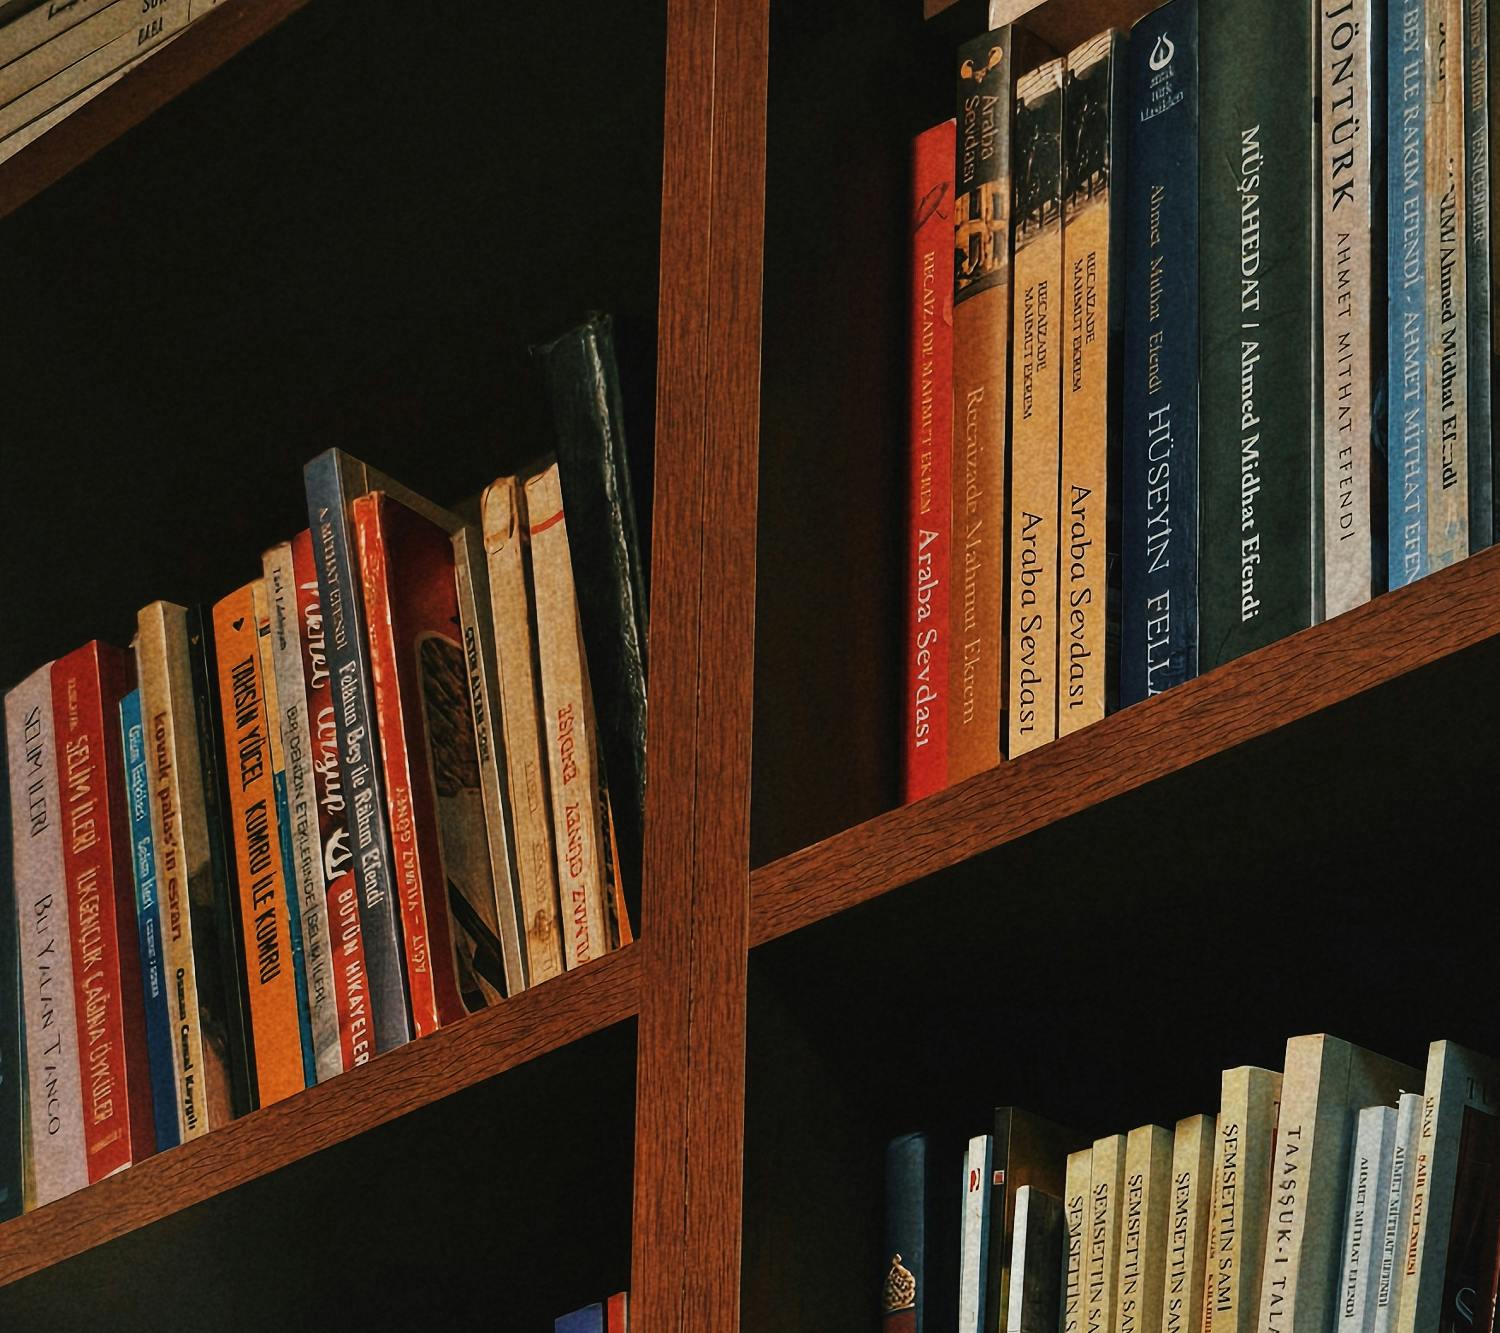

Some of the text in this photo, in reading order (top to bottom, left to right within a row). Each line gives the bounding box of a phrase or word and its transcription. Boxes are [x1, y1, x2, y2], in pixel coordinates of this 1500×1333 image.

[1336, 231, 1350, 317] AHMET
[1238, 124, 1264, 622] MÜŞAHEDAT Ahmed Midhat Efendi
[1403, 310, 1420, 397] AHMET
[1146, 403, 1176, 575] HÜSEYİN
[963, 526, 983, 629] Mahmut
[1019, 511, 1042, 734] Araba Sevdası
[1069, 484, 1092, 709] Araba Sevdası
[914, 527, 938, 748] Araba Sevdası
[961, 637, 982, 724] Ekrem
[237, 729, 266, 793] YÜCEL
[341, 728, 368, 767] Bey
[244, 800, 271, 872] KUMRU
[254, 911, 282, 984] KUMRU
[1275, 1126, 1301, 1263] TAAŞŞUK-I
